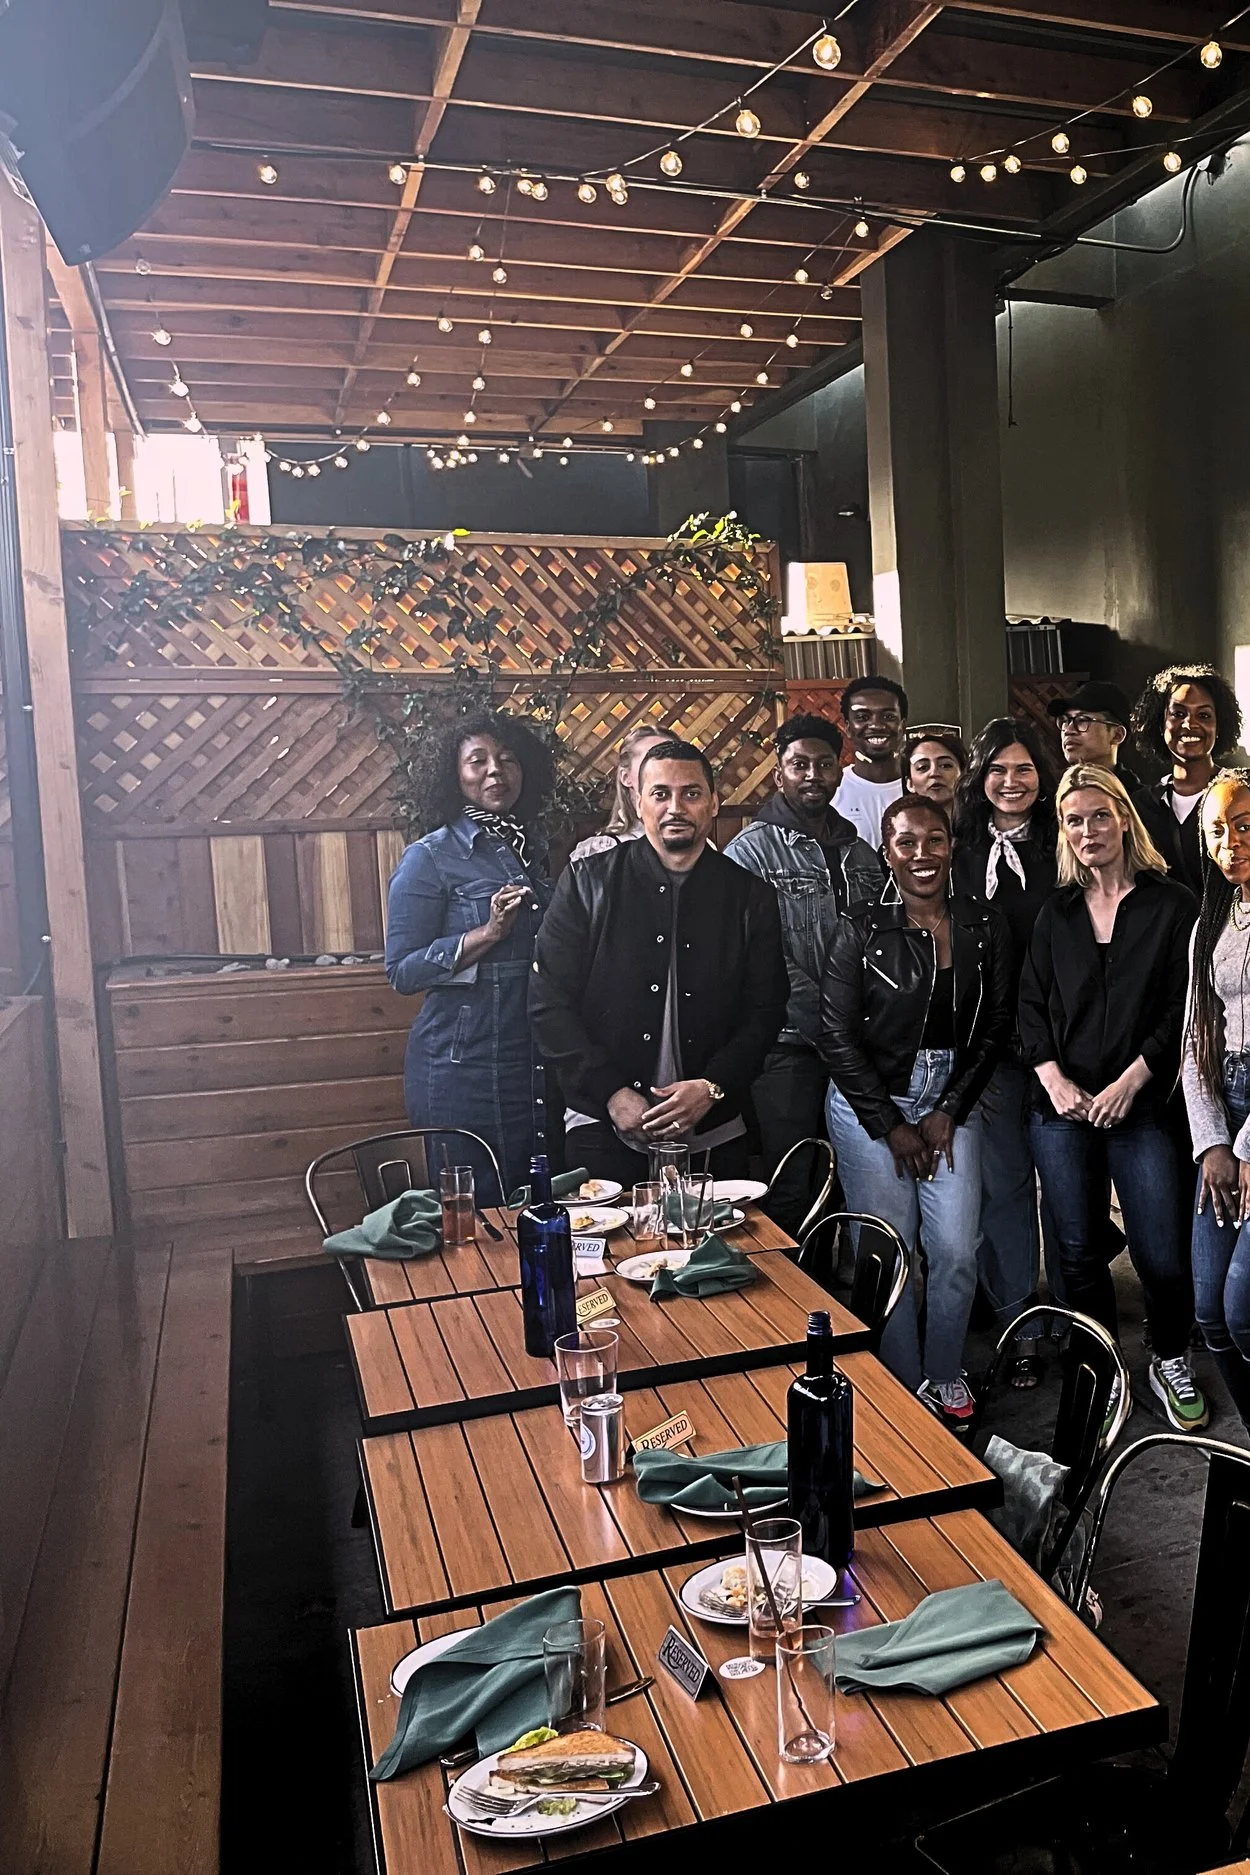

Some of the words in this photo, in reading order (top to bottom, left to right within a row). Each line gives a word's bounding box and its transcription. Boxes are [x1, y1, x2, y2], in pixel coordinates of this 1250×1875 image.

[576, 1293, 609, 1317] ESERVED
[640, 1418, 689, 1450] RESERVED
[662, 1636, 700, 1683] RESERVED
